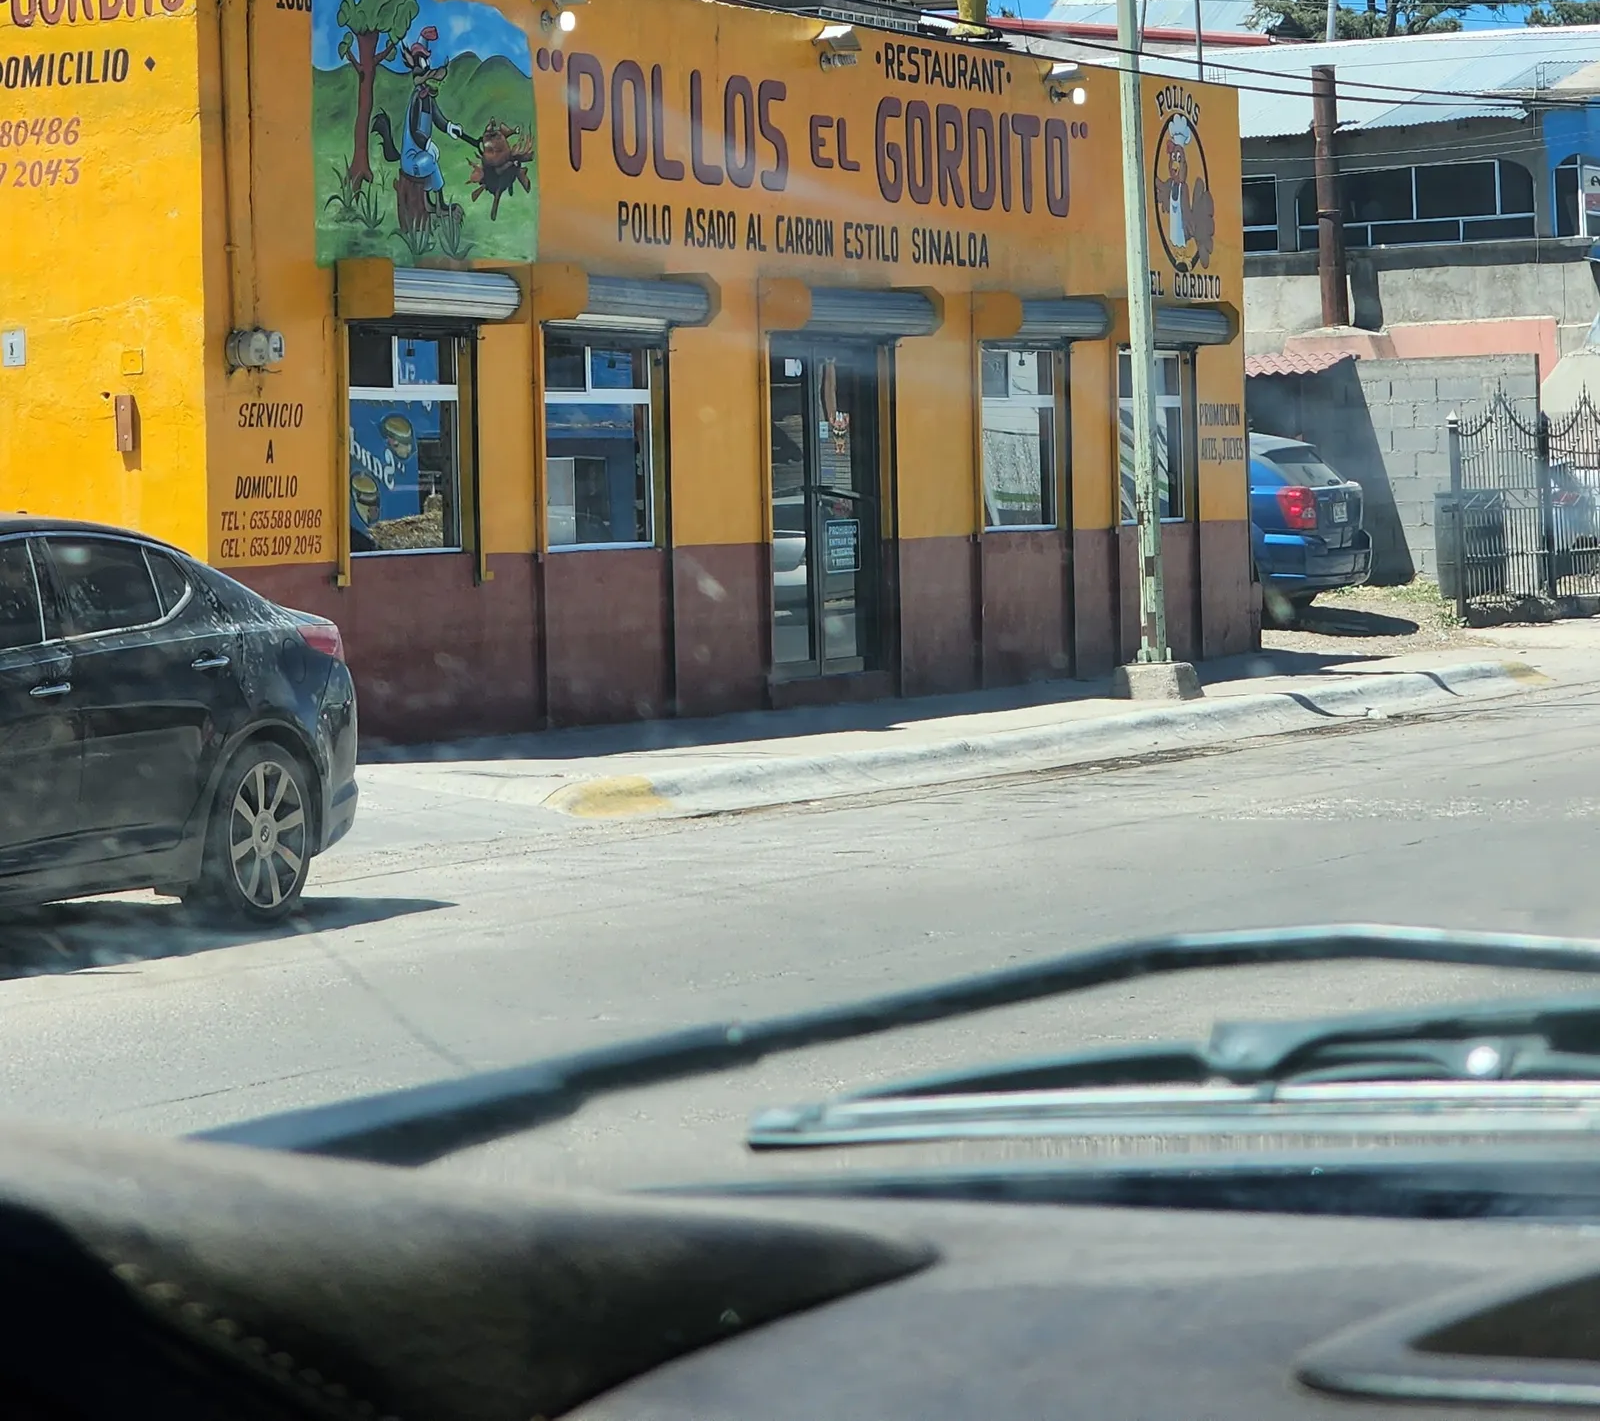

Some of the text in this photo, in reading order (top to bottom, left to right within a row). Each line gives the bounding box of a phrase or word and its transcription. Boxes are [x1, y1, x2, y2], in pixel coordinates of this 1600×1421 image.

[884, 42, 1006, 94] RESTAURANT
[1155, 84, 1201, 127] POLLOS
[808, 114, 861, 172] EL
[13, 156, 82, 188] 2043
[617, 200, 990, 269] POLLO ASADO AL CARBON ESTILO SINALOA
[1174, 271, 1222, 299] GORDITO
[237, 402, 304, 428] SERVICIO
[1199, 403, 1240, 426] PROMOCION
[265, 439, 274, 463] A
[1222, 436, 1244, 461] JUEVES
[235, 475, 298, 499] DOMICILIO
[293, 508, 322, 528] 0486
[249, 535, 269, 557] 635
[270, 535, 292, 556] 109
[293, 534, 322, 555] 2043
